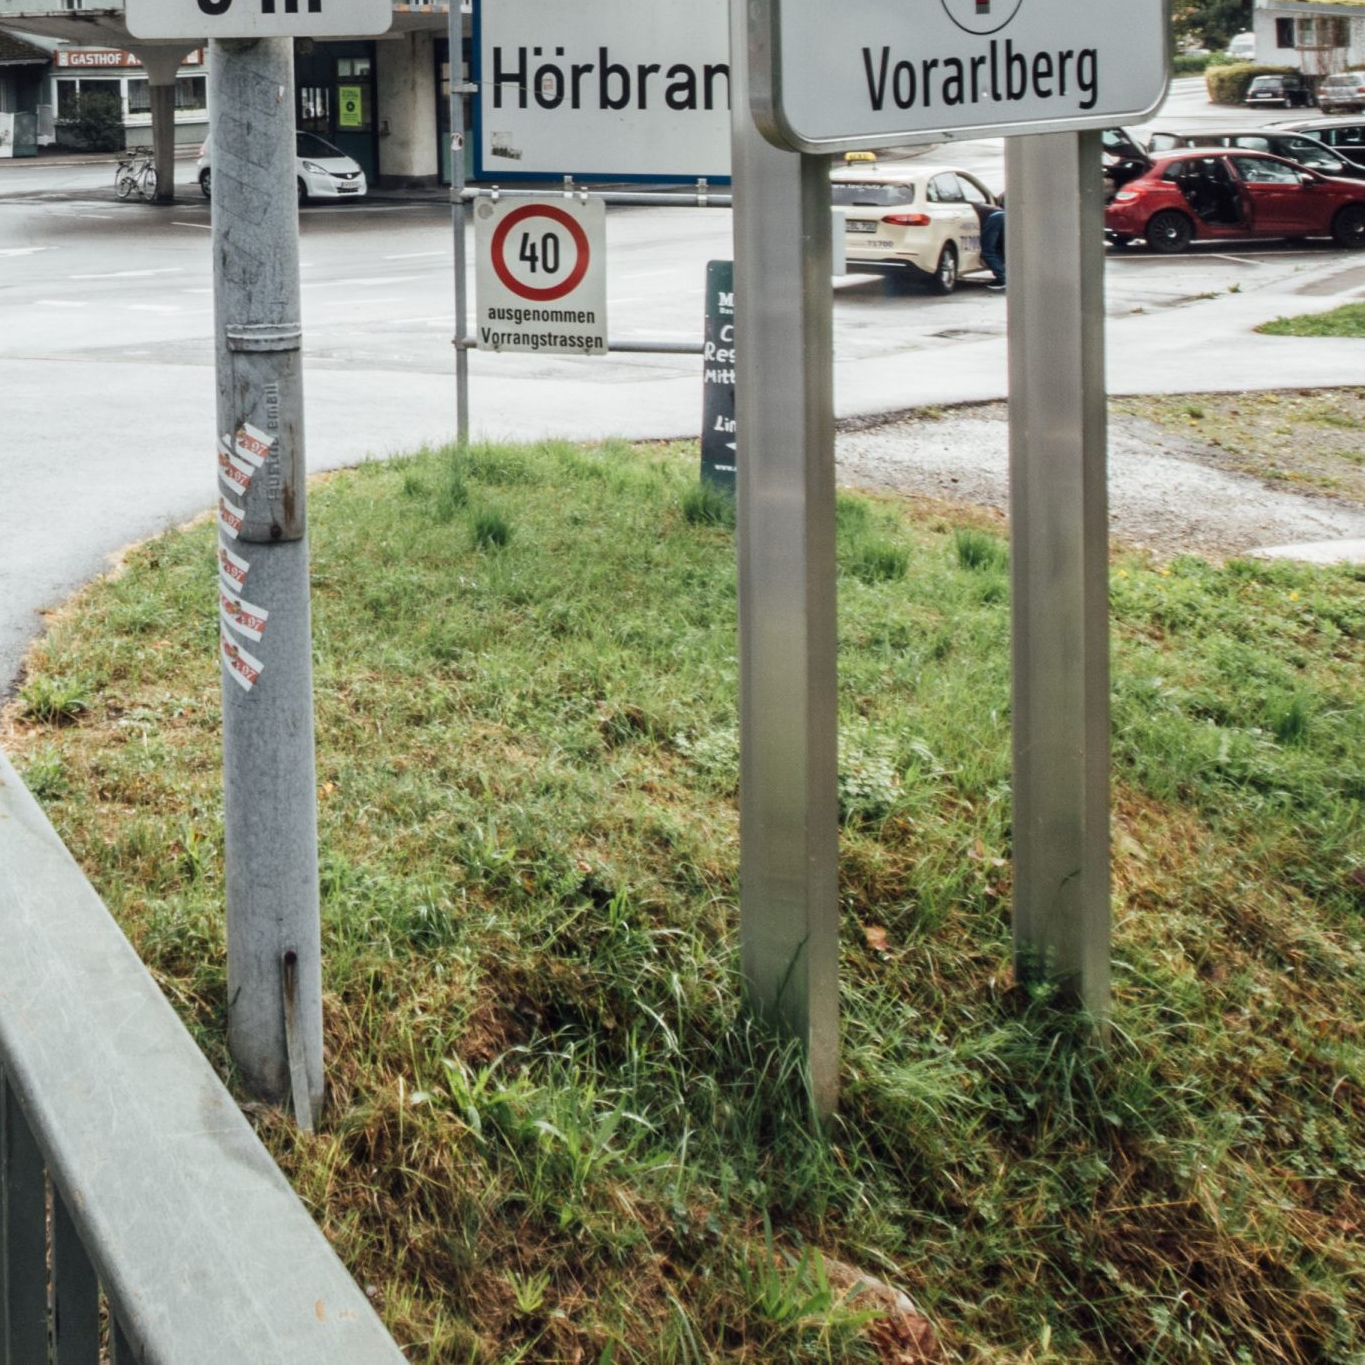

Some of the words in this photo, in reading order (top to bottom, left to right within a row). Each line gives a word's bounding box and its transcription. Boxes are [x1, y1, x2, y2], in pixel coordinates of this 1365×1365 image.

[71, 54, 122, 65] GASTHOF
[862, 39, 1097, 111] Vorarlberg
[519, 232, 559, 274] 40
[488, 307, 595, 324] ausgenommen
[481, 328, 603, 350] Vorrangstrassen
